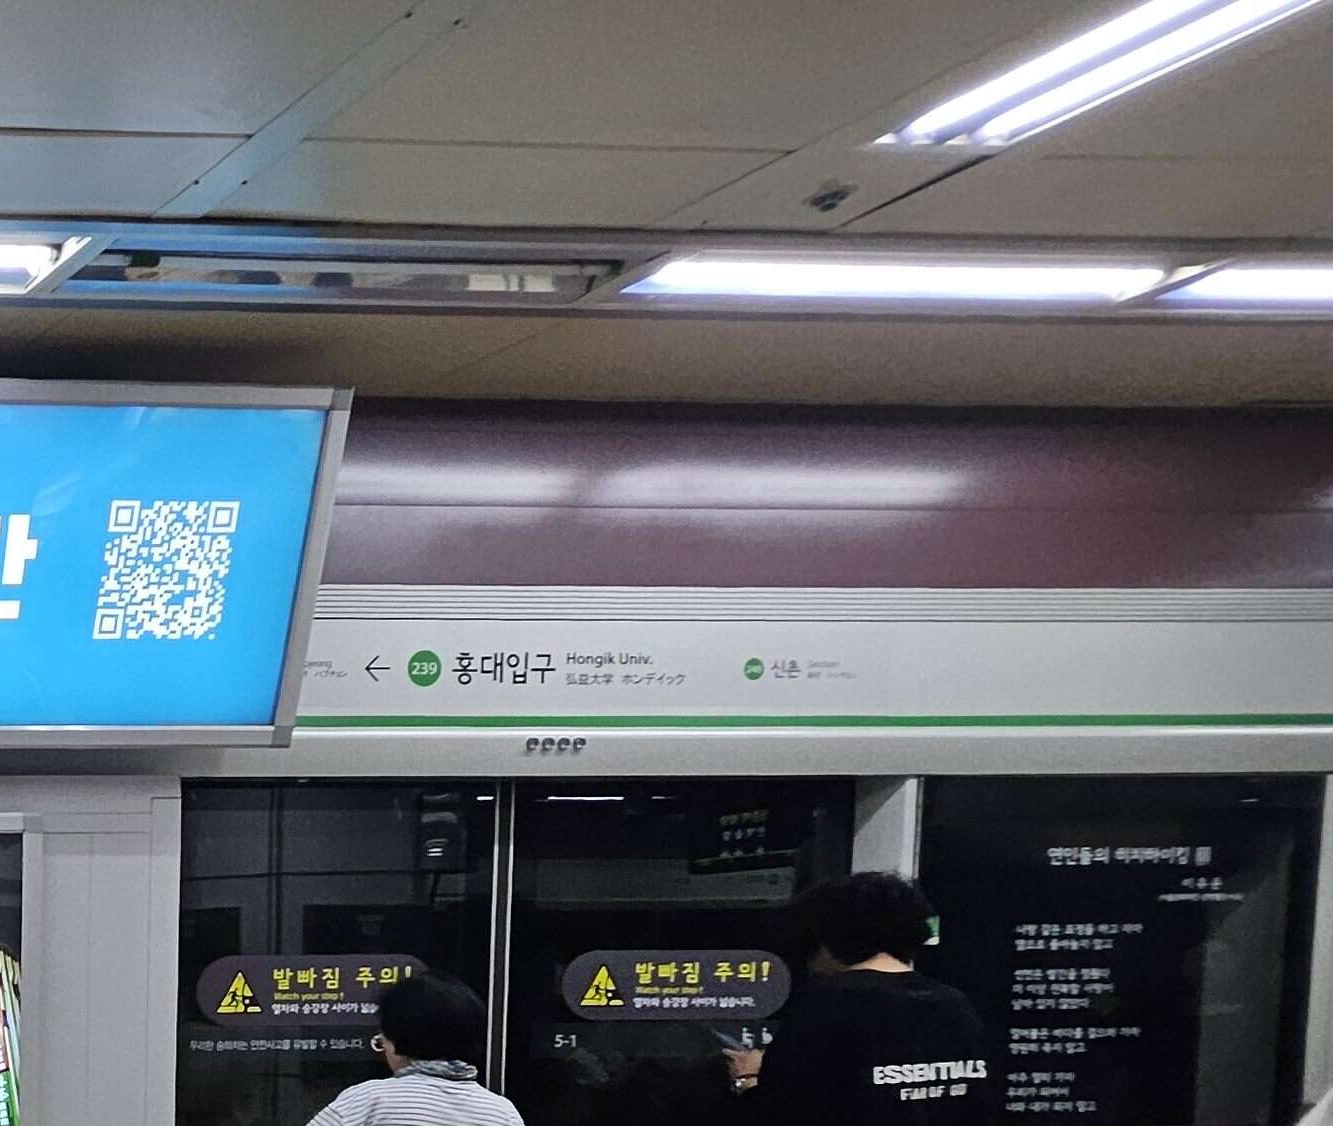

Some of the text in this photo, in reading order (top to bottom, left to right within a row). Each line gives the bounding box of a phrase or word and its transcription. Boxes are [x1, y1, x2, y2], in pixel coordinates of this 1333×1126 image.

[411, 662, 437, 675] 239
[452, 652, 556, 685] 홍대입구
[566, 653, 653, 668] Hongik Univ.
[273, 967, 340, 990] 발빠짐
[714, 961, 771, 983] 주의!
[554, 1034, 577, 1048] 5-1
